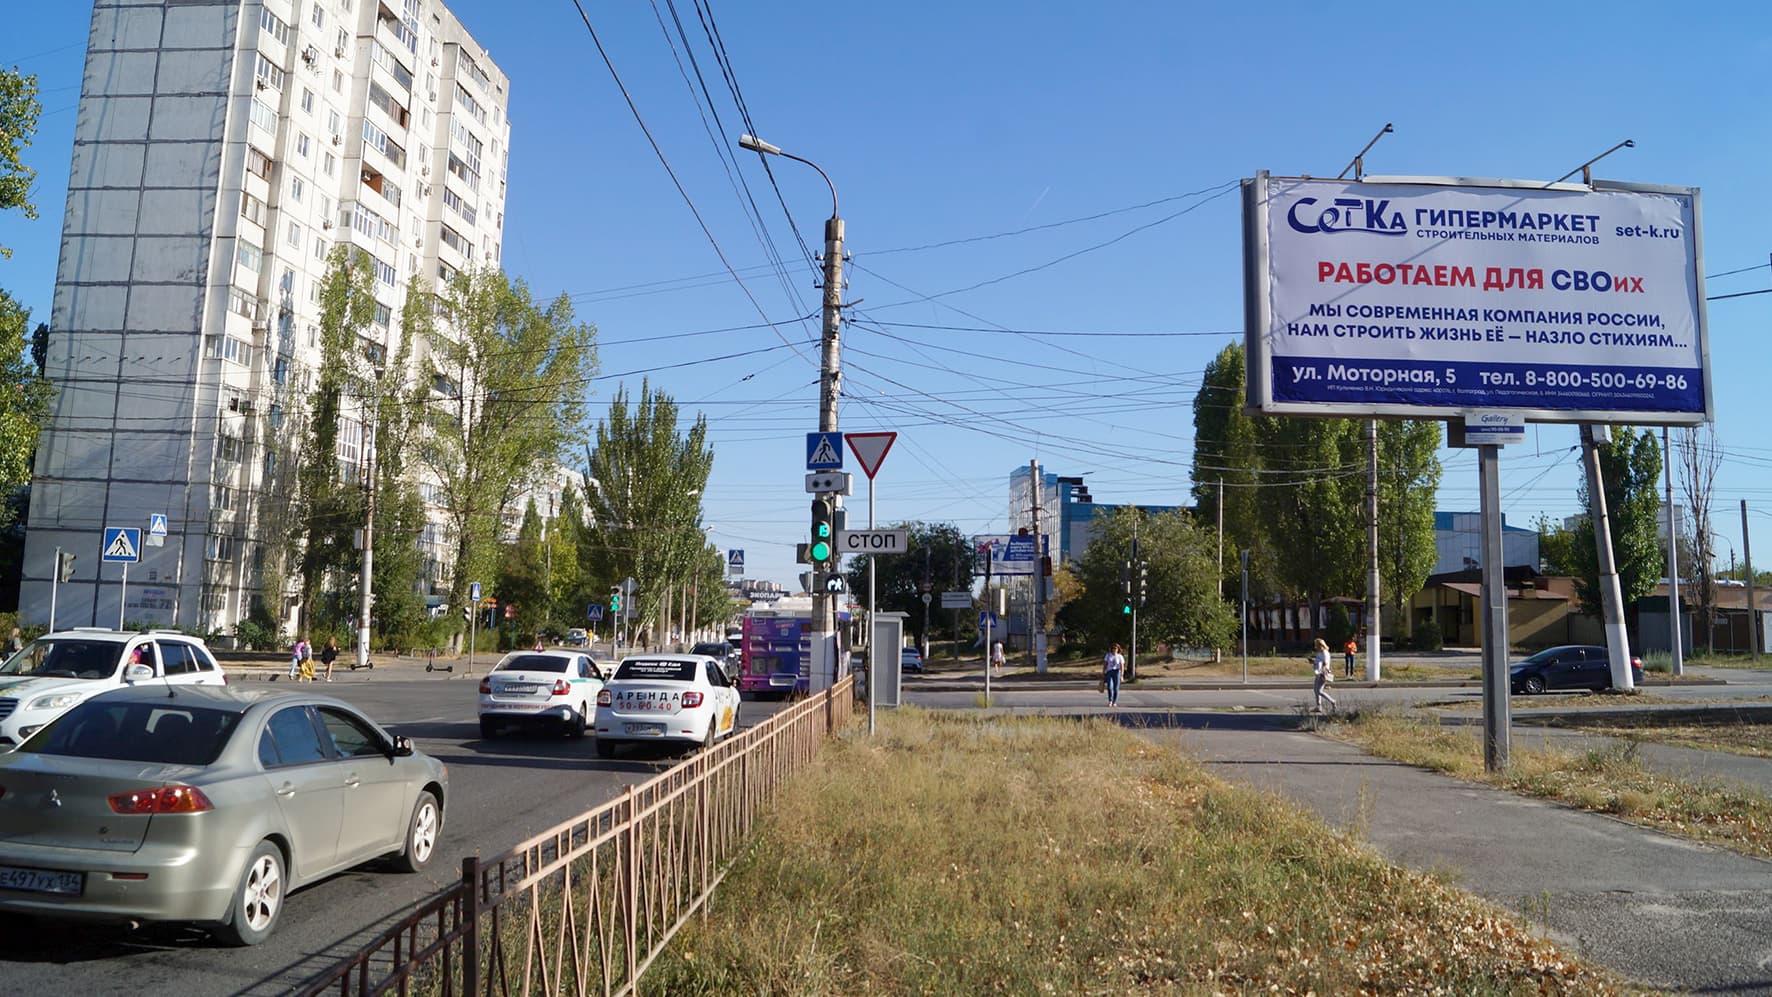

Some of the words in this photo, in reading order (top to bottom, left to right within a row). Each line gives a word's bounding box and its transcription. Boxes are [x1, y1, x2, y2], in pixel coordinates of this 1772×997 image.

[1415, 208, 1600, 233] ГИПЕРМАРКЕТ
[1416, 229, 1515, 242] СТРОИТЕЛЬНЫХ
[1518, 233, 1600, 245] МАТЕРИАЛОВ
[1615, 225, 1680, 239] set-k.ru
[1318, 261, 1476, 288] РАБОТАЕМ
[1483, 267, 1544, 292] ДЛЯ
[1309, 303, 1341, 317] МЫ
[1346, 305, 1479, 322] СОВРЕМЕННАЯ
[1483, 309, 1583, 325] КОМПАНИЯ
[1587, 312, 1665, 330] РОССИИ,
[1287, 323, 1329, 337] НАМ
[1333, 324, 1416, 340] СТРОИТЬ
[1419, 327, 1482, 342] ЖИЗНЬ
[1486, 326, 1504, 342] ЕЁ
[1526, 330, 1585, 345] НАЗЛО
[1589, 332, 1688, 348] СТИХИЯМ...
[1292, 366, 1322, 383] ул.
[1327, 365, 1441, 386] Моторная,
[1446, 368, 1457, 384] 5
[1480, 371, 1520, 386] тел.
[1525, 371, 1688, 390] 8-800-500-69-86
[848, 534, 896, 548] СТОП
[616, 691, 680, 701] АРЕНДА
[619, 701, 673, 711] 50-60-40
